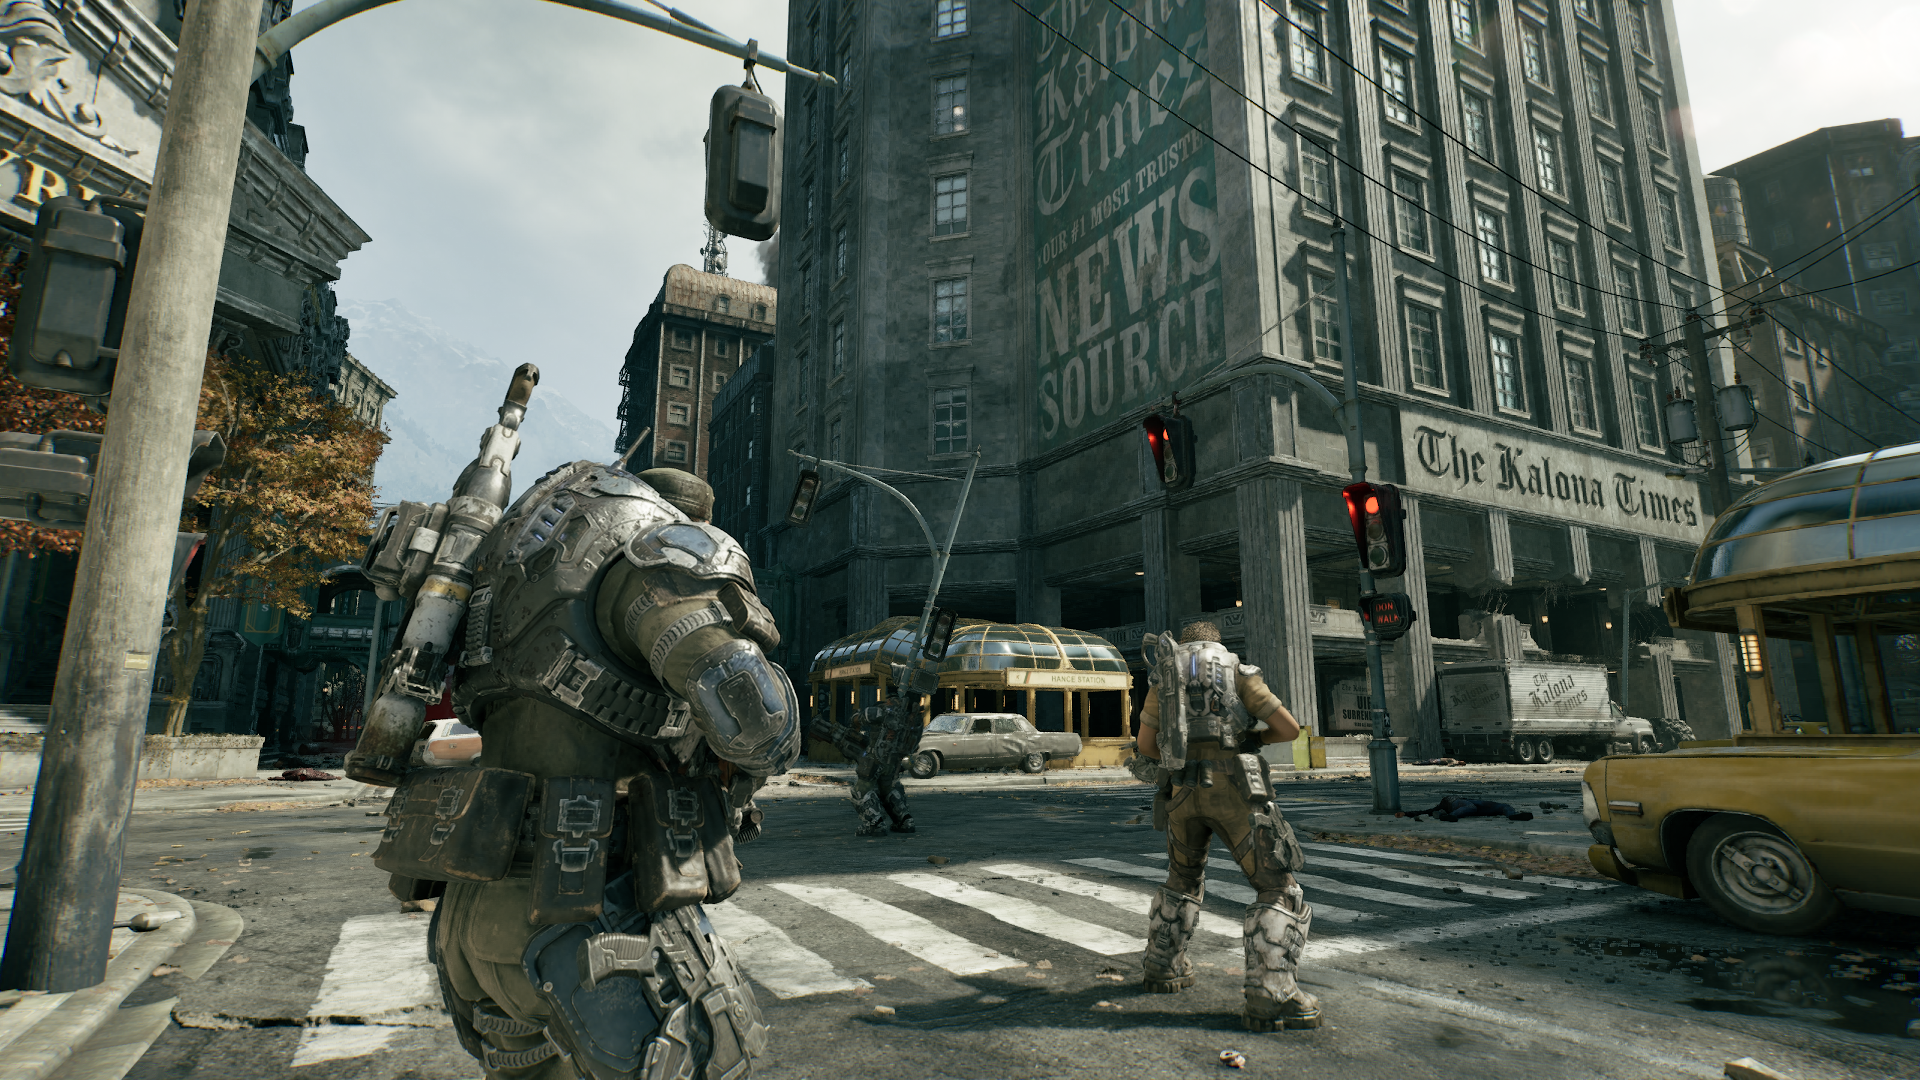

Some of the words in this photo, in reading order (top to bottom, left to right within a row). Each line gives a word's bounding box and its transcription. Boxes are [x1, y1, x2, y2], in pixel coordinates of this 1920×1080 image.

[1036, 166, 1221, 367] NEWS
[1038, 230, 1068, 270] YOUR
[1071, 218, 1087, 245] #1
[1091, 181, 1132, 230] MOST
[1038, 277, 1221, 440] SOURCE
[1413, 424, 1487, 492] The
[1493, 441, 1606, 511] Kalona
[1613, 471, 1699, 528] Times
[1051, 675, 1076, 683] HANCE
[1077, 676, 1106, 684] STATION
[1528, 673, 1575, 711] Kalona
[1533, 672, 1549, 687] The
